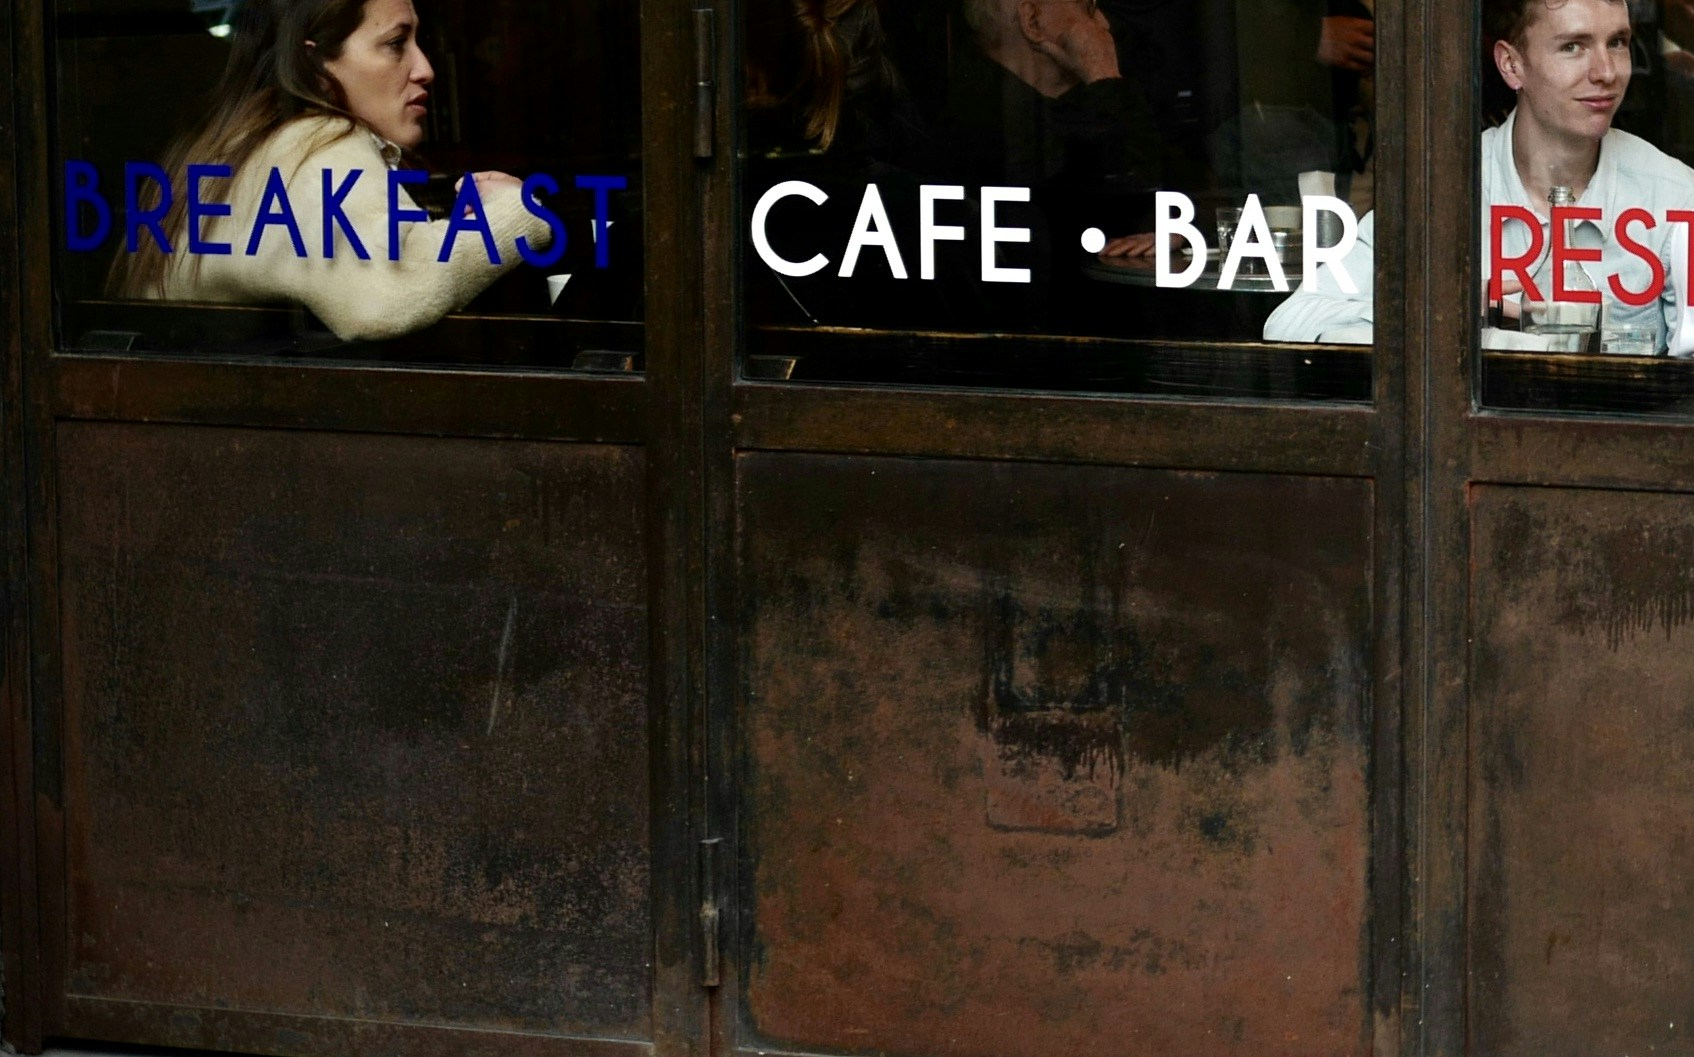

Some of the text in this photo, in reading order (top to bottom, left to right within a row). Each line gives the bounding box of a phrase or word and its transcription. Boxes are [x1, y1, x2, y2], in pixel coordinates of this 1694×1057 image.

[63, 158, 628, 269] BREAKFAST
[751, 180, 1360, 295] CAFE BAR
